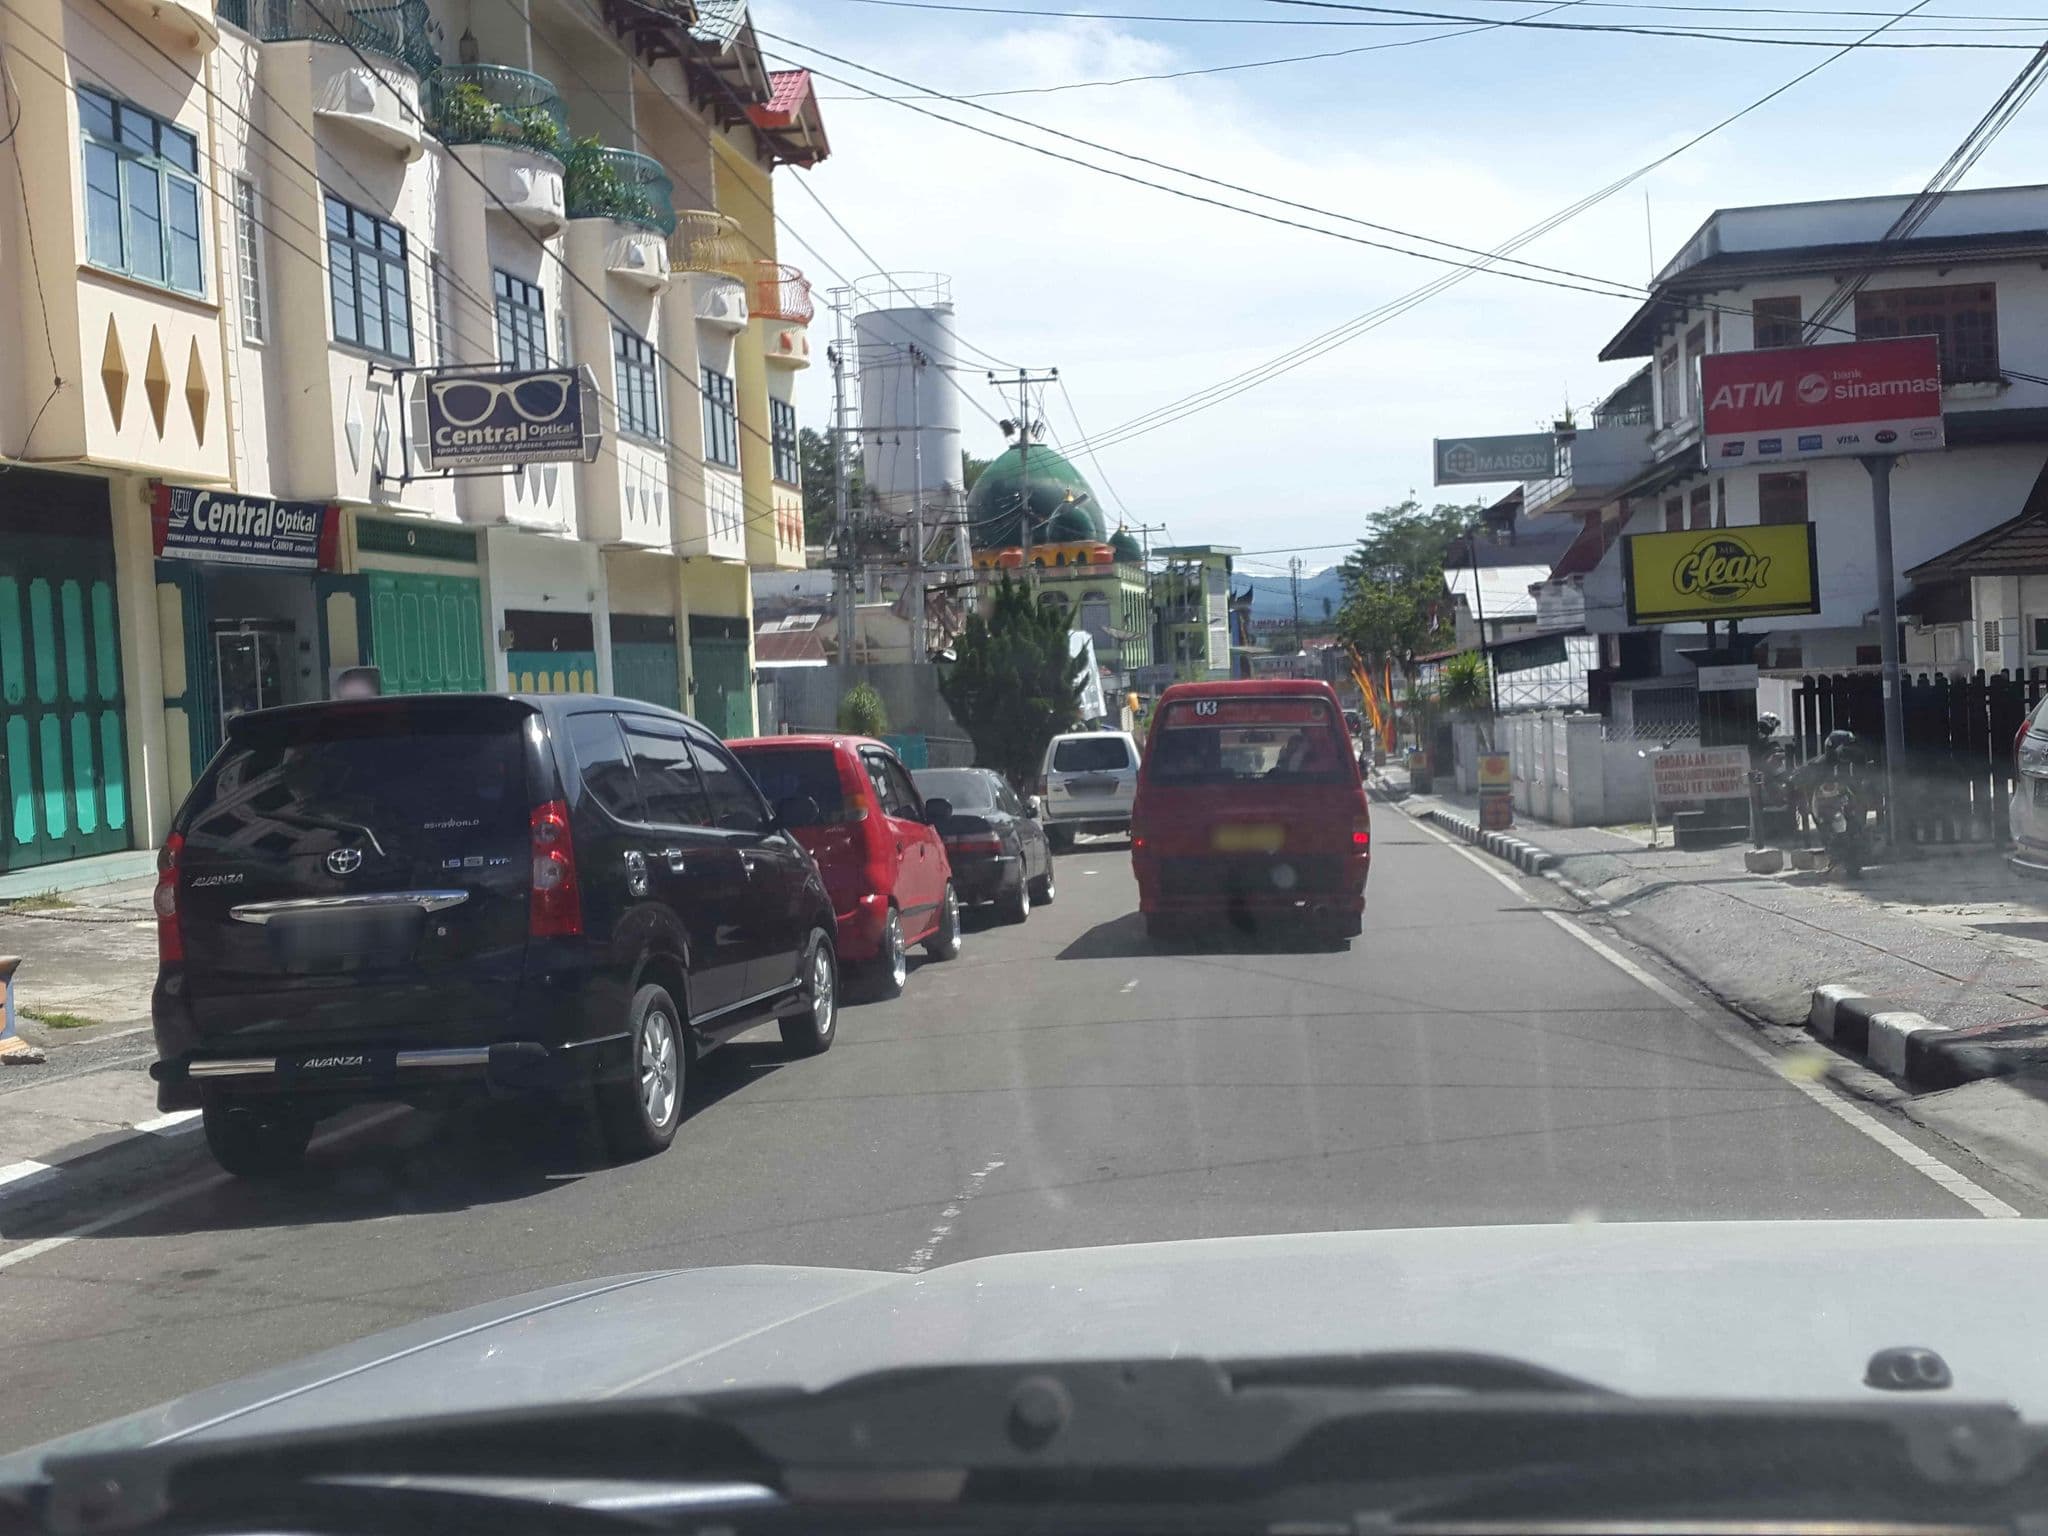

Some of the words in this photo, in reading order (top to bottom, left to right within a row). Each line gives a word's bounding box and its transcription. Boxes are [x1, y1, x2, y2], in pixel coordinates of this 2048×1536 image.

[1832, 369, 1863, 381] bank
[1708, 380, 1785, 411] ATM
[1834, 377, 1939, 400] sinarmas
[435, 422, 528, 446] Central
[529, 422, 574, 438] Optical
[1836, 433, 1861, 445] VISA
[1480, 453, 1548, 469] MAISON
[170, 489, 192, 518] NEW
[192, 491, 276, 537] Central
[275, 508, 317, 535] Optical
[1673, 544, 1771, 595] Clean
[1195, 701, 1218, 716] 03
[191, 872, 244, 888] AVANZA
[302, 1055, 364, 1069] AVANZA
